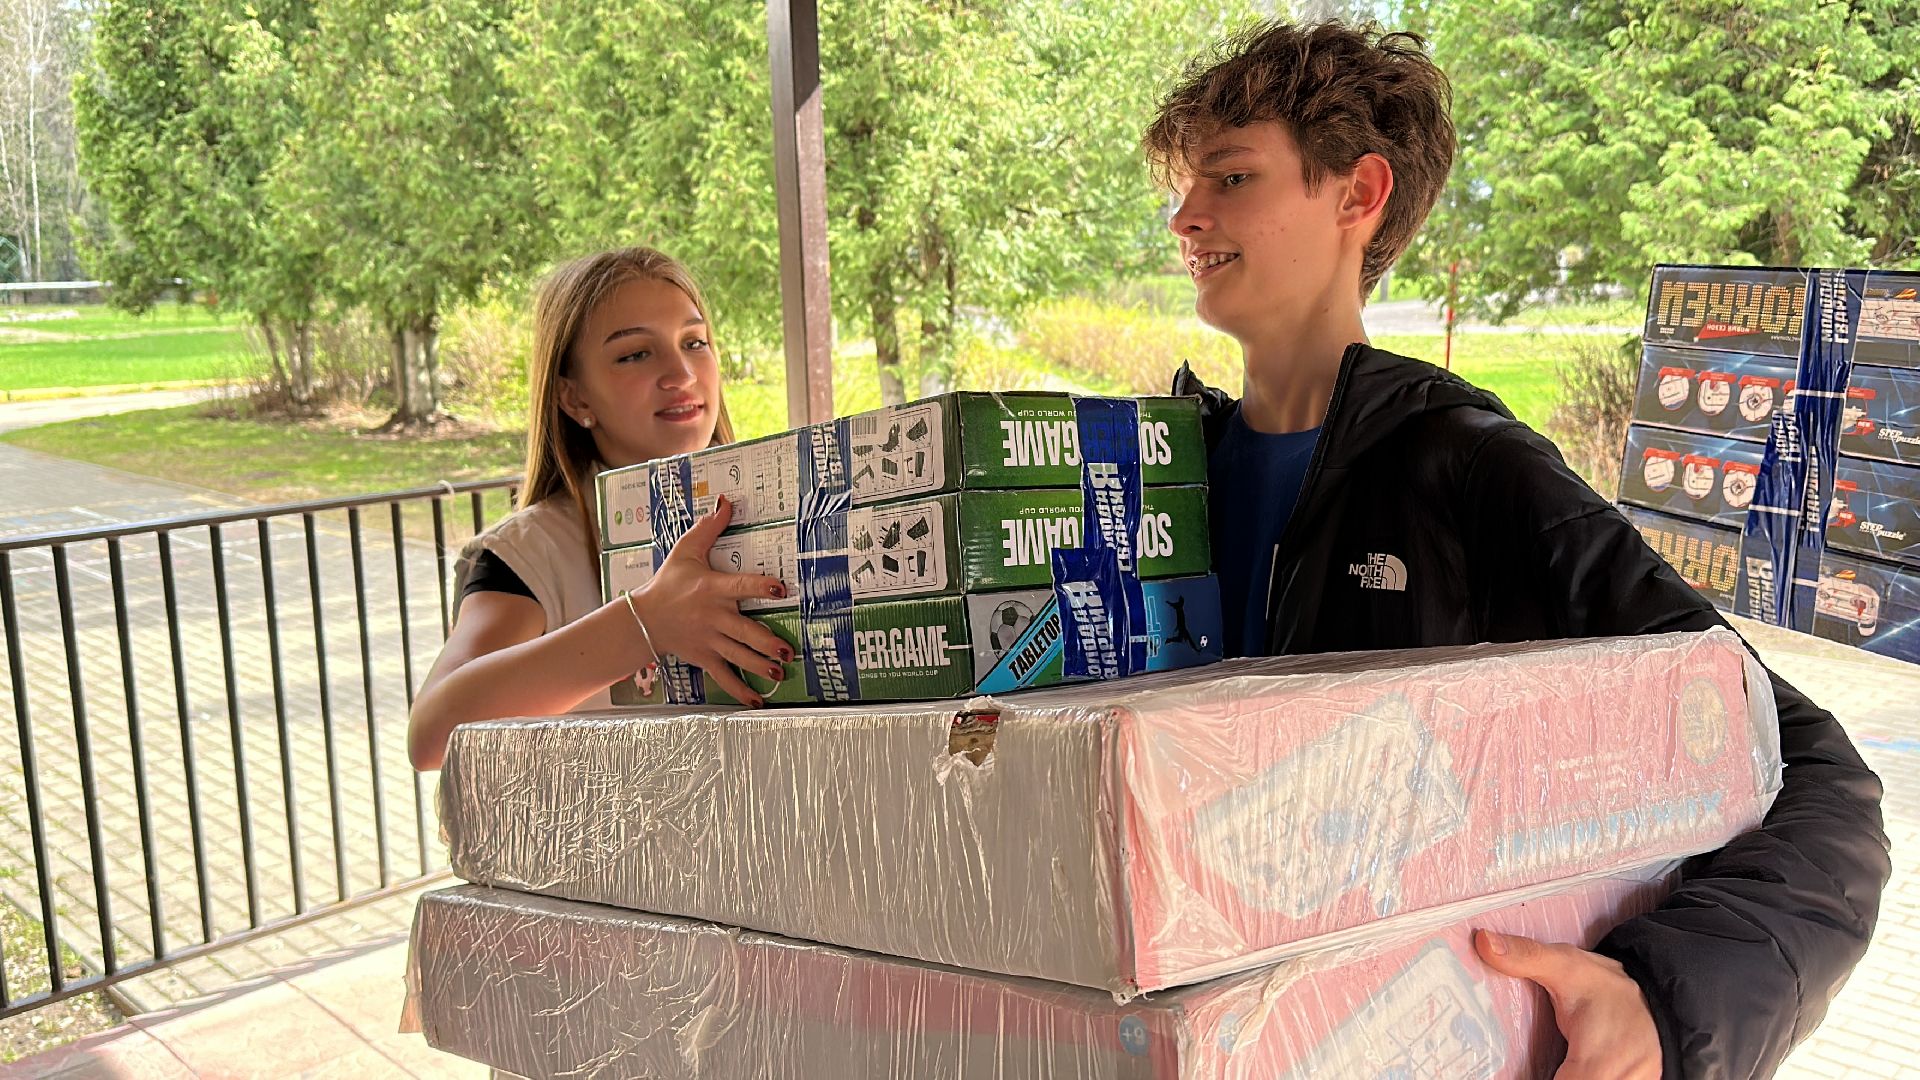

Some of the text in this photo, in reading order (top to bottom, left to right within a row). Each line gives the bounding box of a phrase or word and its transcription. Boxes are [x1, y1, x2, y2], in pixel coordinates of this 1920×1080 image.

[1819, 272, 1833, 343] МОЛОДА
[1832, 273, 1850, 344] ГВАРДИ
[1017, 409, 1034, 417] CUP
[1001, 420, 1082, 467] GAME
[1895, 435, 1920, 446] puzzl
[1019, 507, 1035, 515] CUP
[1038, 506, 1066, 514] WORLD
[1348, 563, 1383, 577] NOTH
[854, 625, 951, 670] CER GAME
[1008, 613, 1062, 681] TABLETOP
